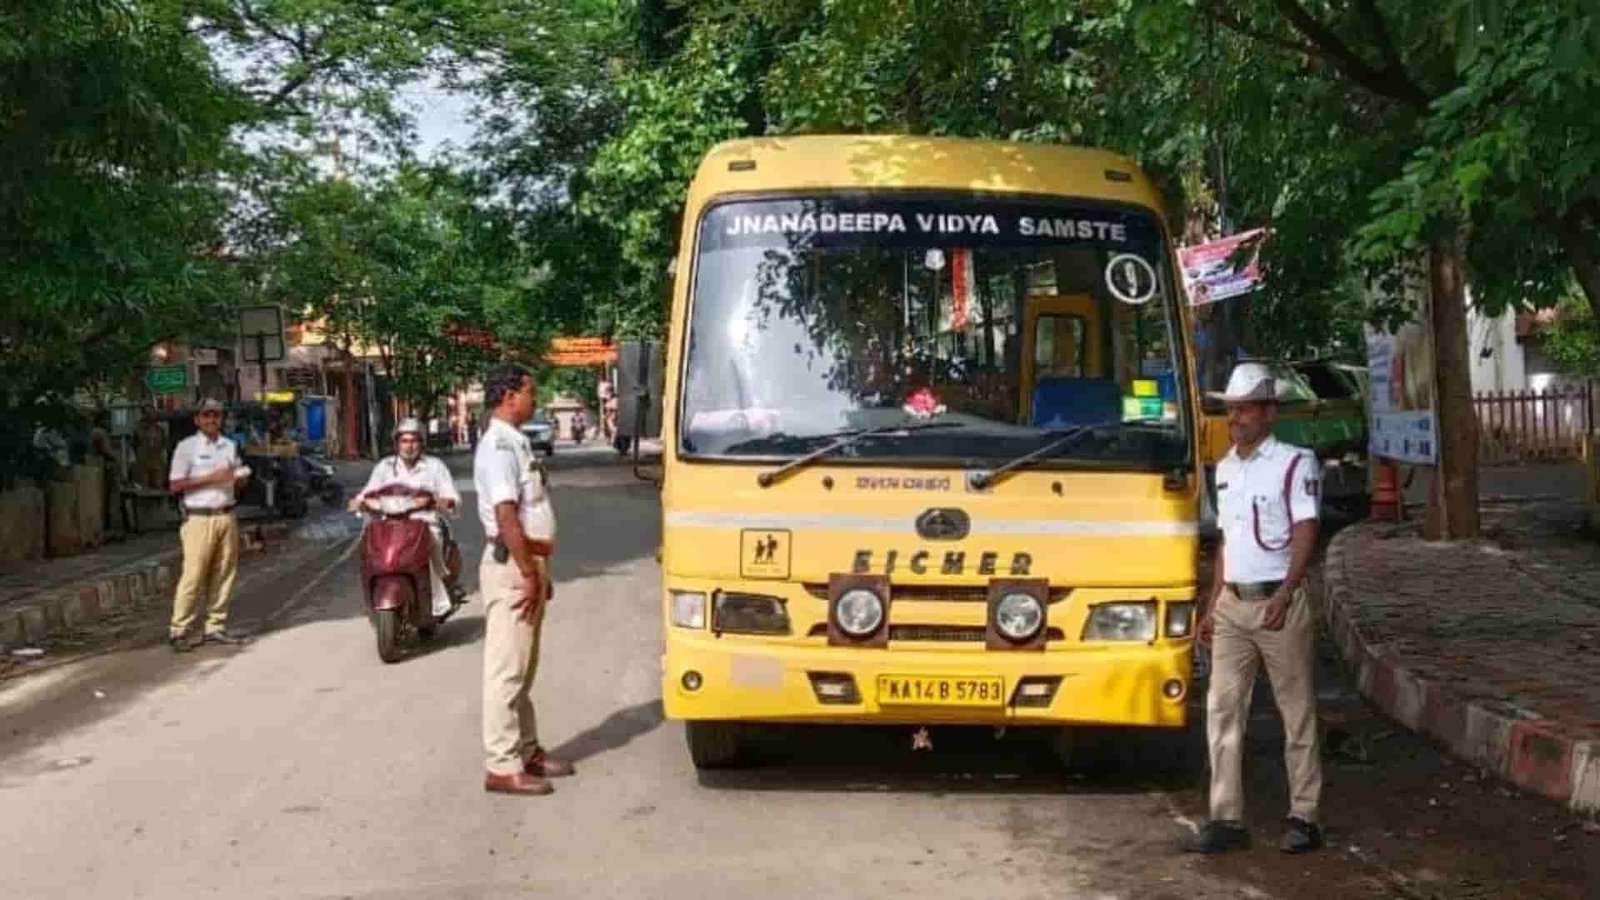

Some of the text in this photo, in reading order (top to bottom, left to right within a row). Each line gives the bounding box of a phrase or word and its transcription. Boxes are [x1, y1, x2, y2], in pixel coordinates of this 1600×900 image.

[726, 212, 1127, 242] JNANADEEPA VIDYA SAMSTE
[853, 549, 1032, 575] EICHER
[955, 681, 1000, 700] 5783
